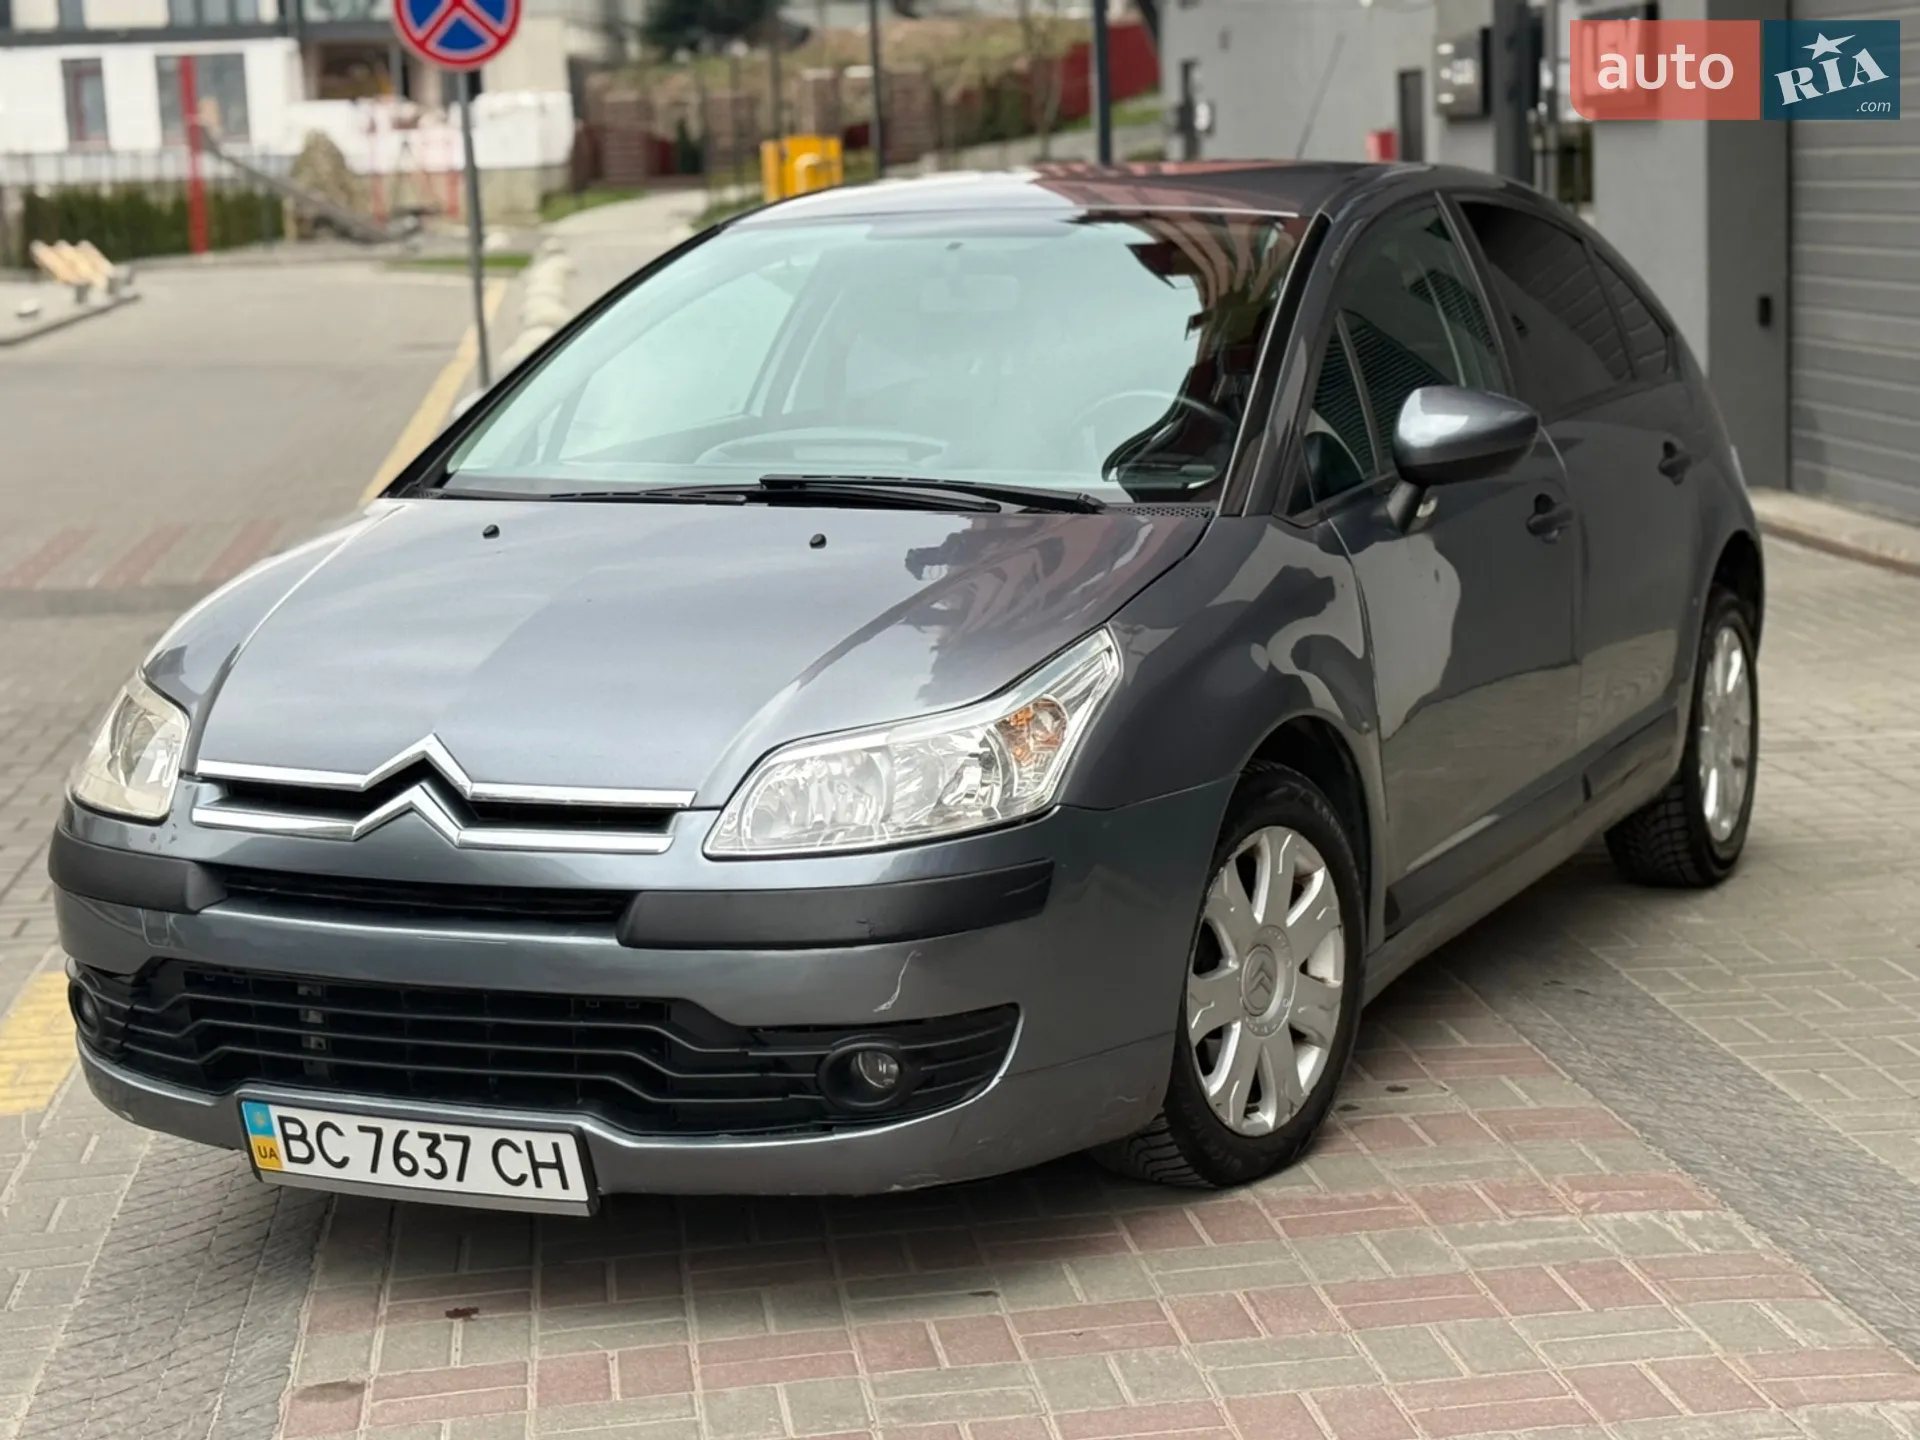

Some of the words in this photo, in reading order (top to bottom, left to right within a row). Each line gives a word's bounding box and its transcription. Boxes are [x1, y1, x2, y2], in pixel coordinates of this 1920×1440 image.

[257, 1145, 279, 1161] UA
[277, 1115, 350, 1169] BC
[358, 1125, 471, 1182] 7637
[491, 1138, 570, 1190] CH
